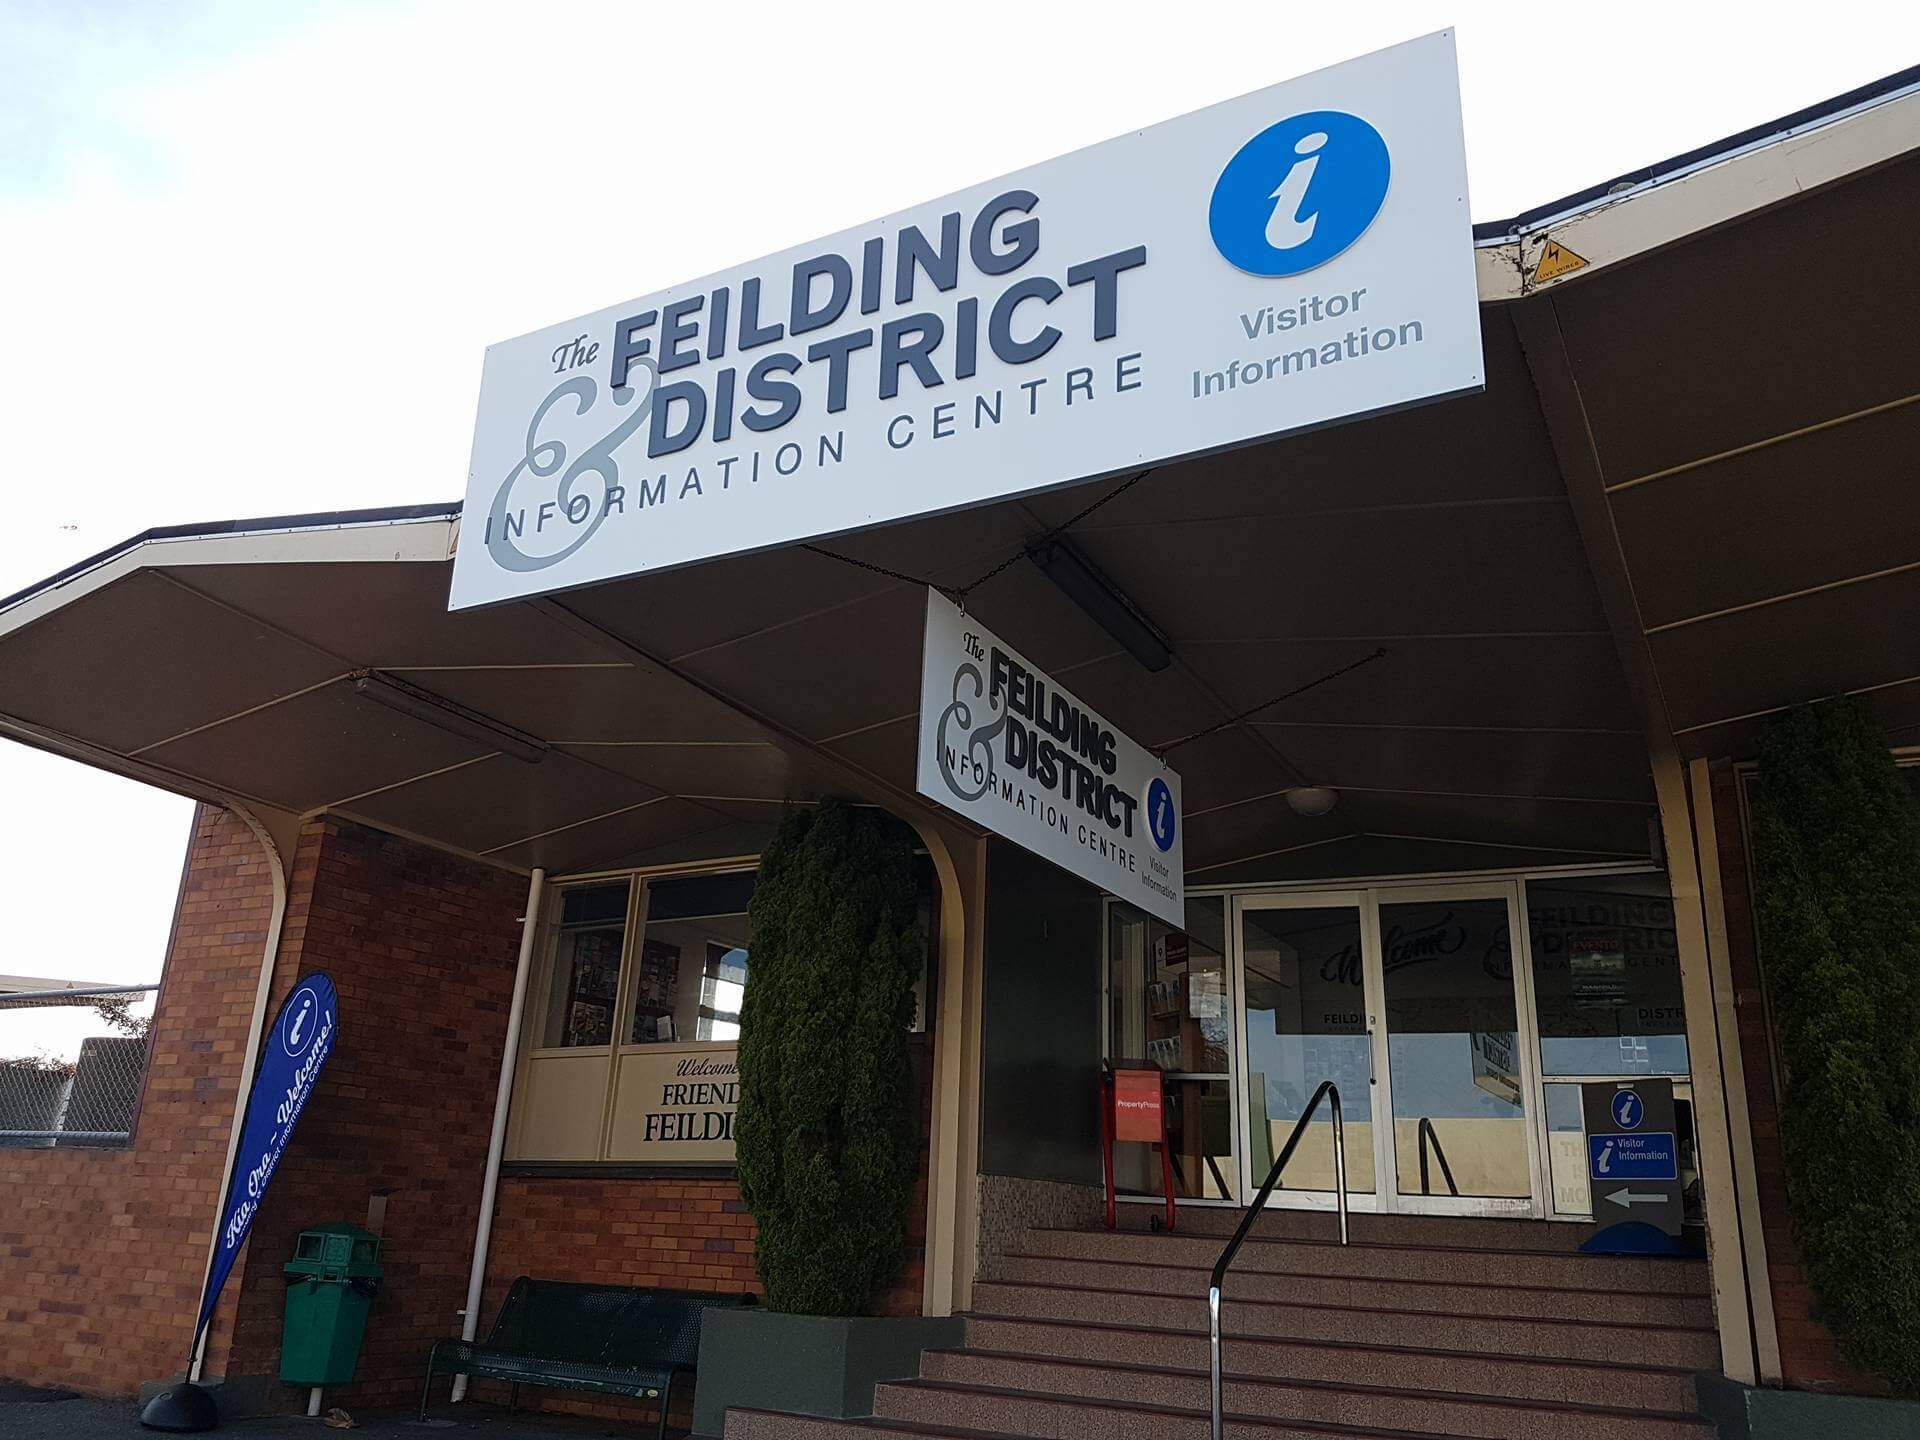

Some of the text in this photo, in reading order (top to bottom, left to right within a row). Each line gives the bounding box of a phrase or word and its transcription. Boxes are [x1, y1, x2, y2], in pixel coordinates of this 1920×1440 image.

[552, 190, 1040, 388] The FEILDING
[1240, 288, 1367, 340] Visitor
[648, 245, 1146, 459] DISTRICT
[1193, 320, 1424, 398] Information
[485, 352, 1142, 544] INFORMATION CENTRE
[963, 632, 1117, 776] The FEILDING
[936, 740, 1136, 873] INFORMATION CENTRE
[1004, 715, 1137, 838] DISTRICT
[1141, 871, 1177, 903] Information
[1149, 855, 1169, 881] Visitor
[226, 1200, 252, 1249] Kia
[248, 1152, 271, 1198] Ora
[276, 1010, 332, 1125] Welcome!
[643, 1111, 738, 1141] FEILDI
[1617, 1138, 1645, 1149] Visitor
[1618, 1150, 1668, 1161] Information
